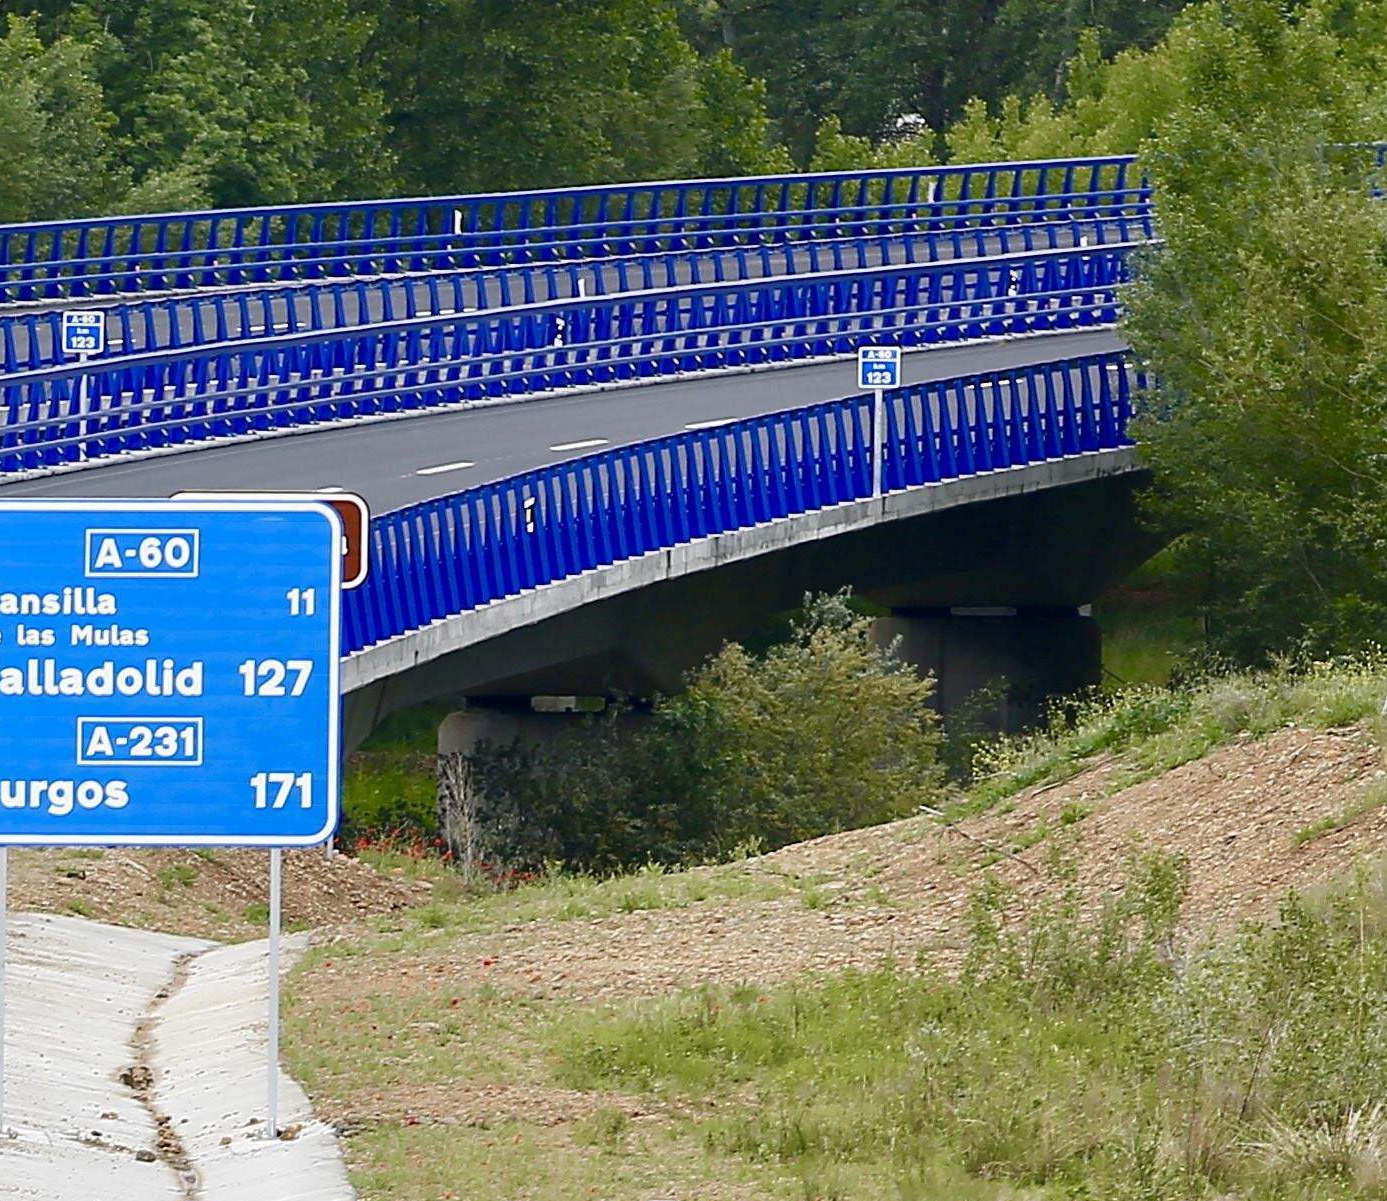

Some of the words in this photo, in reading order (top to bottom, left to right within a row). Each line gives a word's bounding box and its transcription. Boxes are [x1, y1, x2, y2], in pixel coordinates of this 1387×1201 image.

[71, 336, 96, 349] 123
[866, 371, 892, 384] 123
[94, 537, 190, 568] A-60
[286, 588, 316, 616] 11
[16, 624, 56, 646] las
[70, 624, 150, 647] Mulas
[238, 659, 314, 697] 127
[86, 726, 196, 757] A-231
[249, 772, 313, 809] 171
